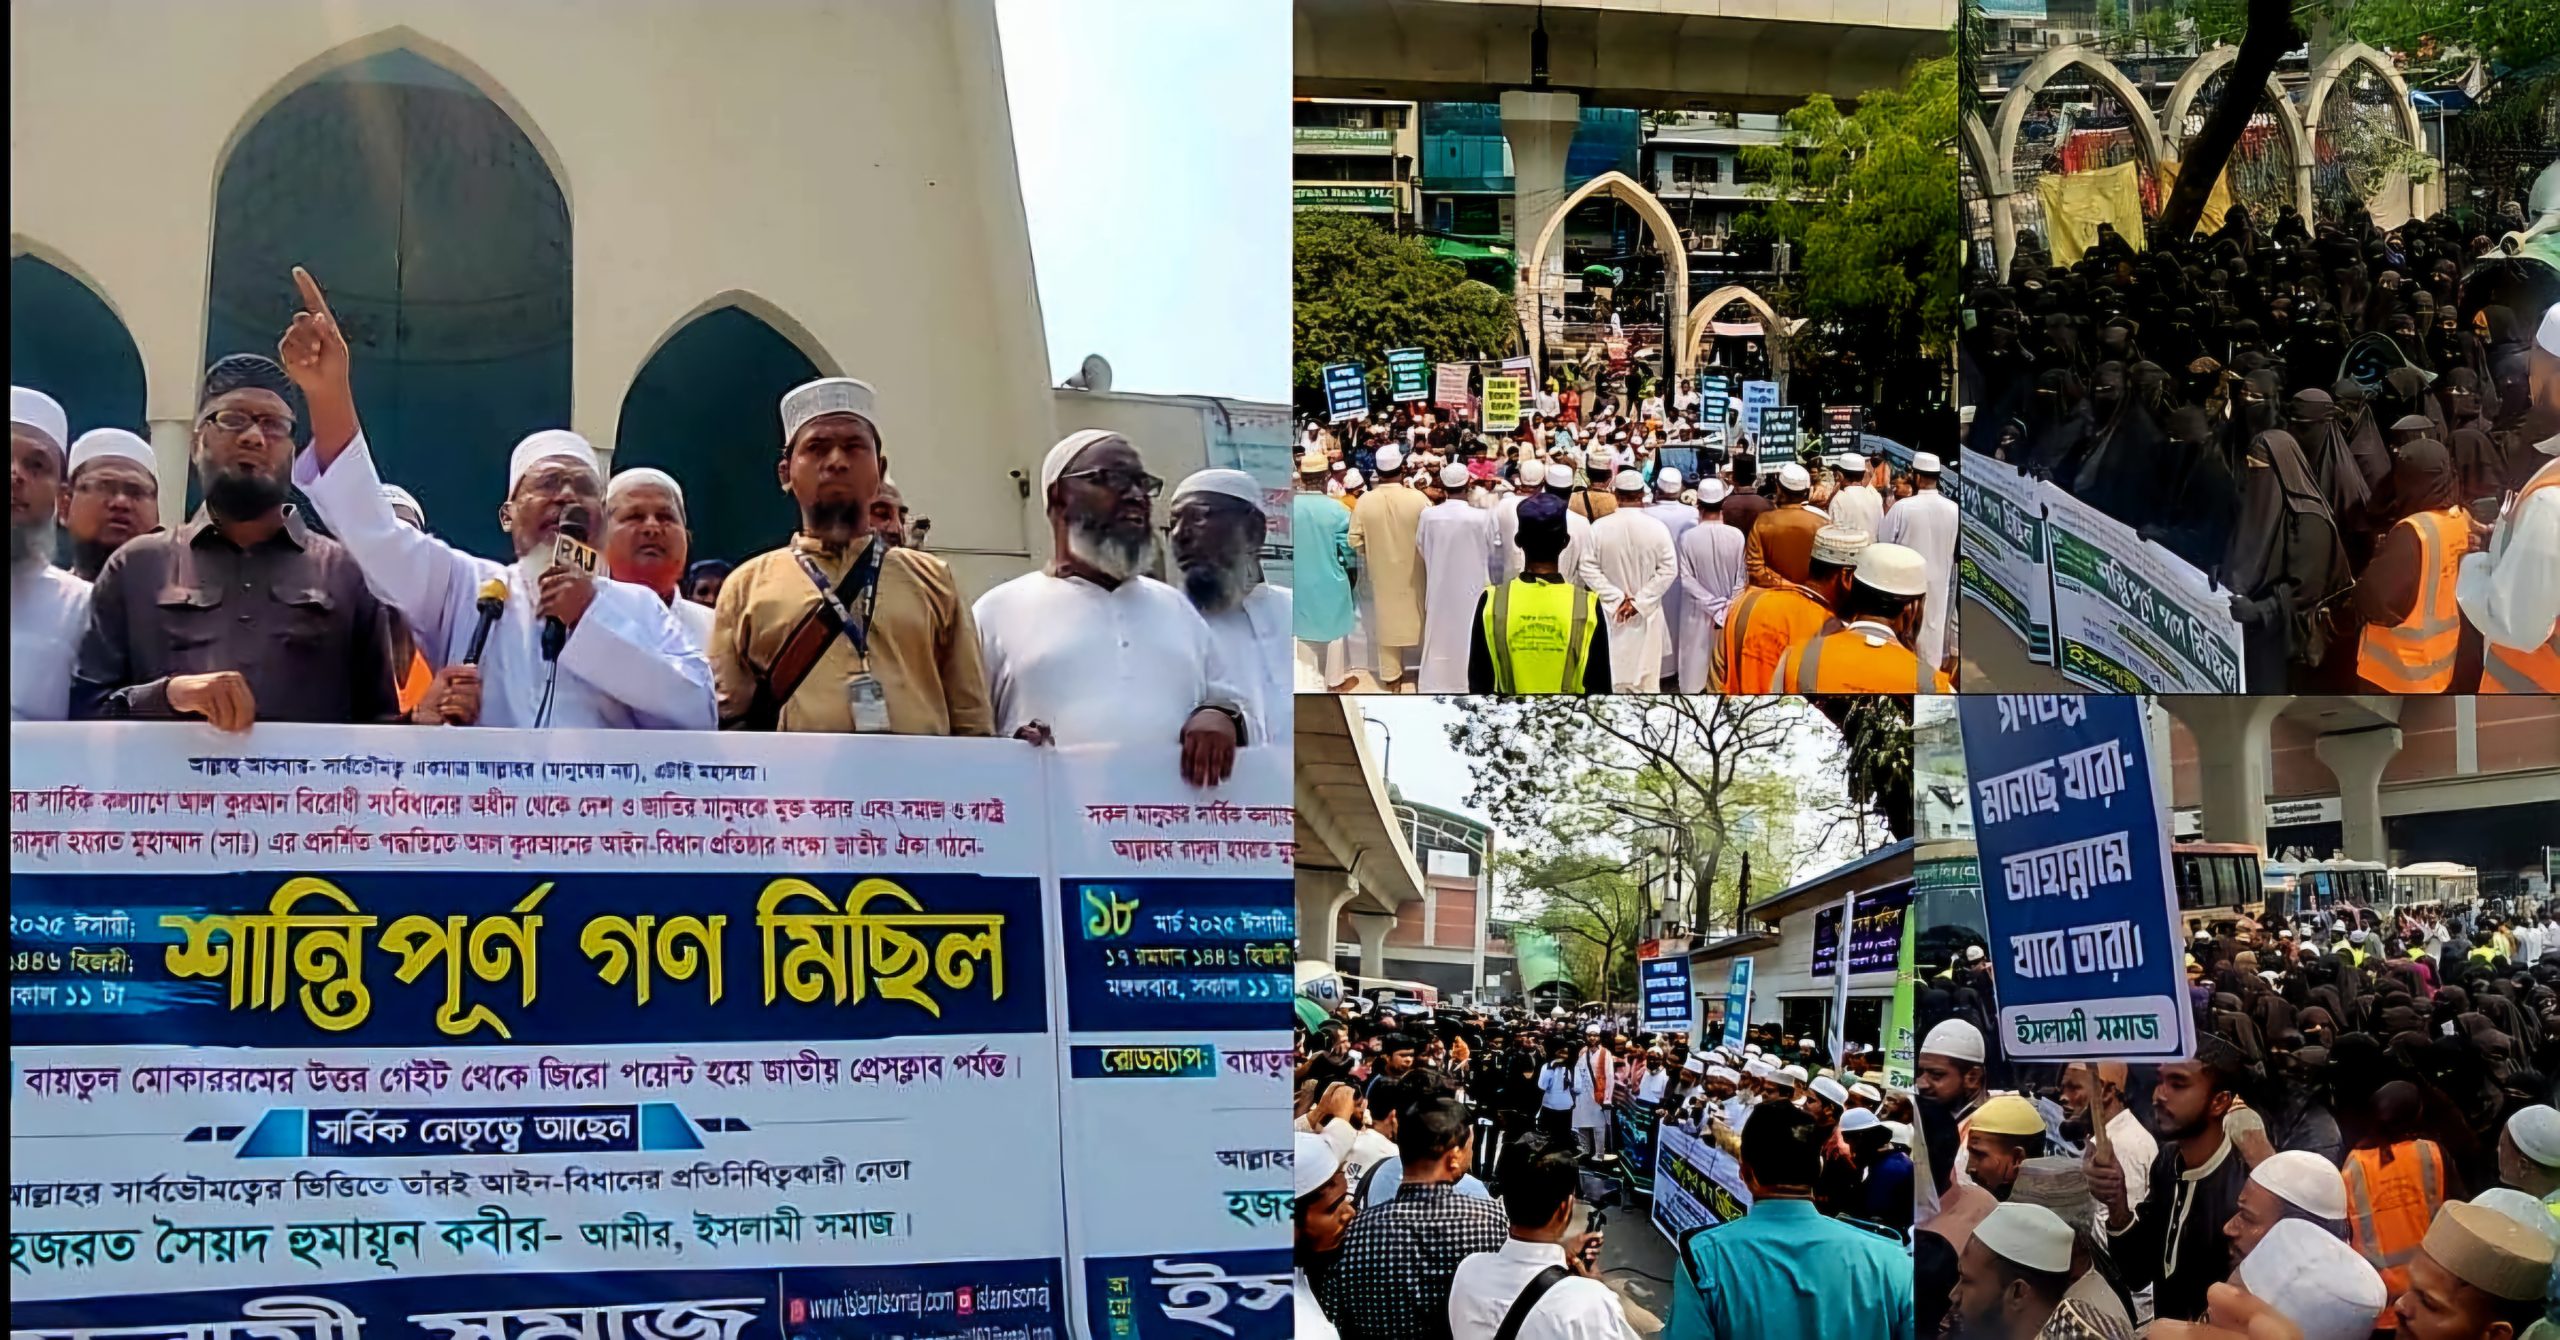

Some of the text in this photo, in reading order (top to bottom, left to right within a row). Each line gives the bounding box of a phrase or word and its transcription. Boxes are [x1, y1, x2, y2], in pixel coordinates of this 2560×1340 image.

[296, 787, 360, 816] বিরোধী
[526, 797, 571, 817] থেকে
[1977, 759, 2059, 824] মানছে
[268, 832, 298, 854] এর
[2001, 831, 2132, 901] জাহান্নামে
[1085, 888, 1140, 937] ১৮
[1190, 914, 1237, 937] ২০২৫
[159, 876, 1004, 1039] শান্তিপূর্ণ গণ মিছিল
[2011, 930, 2067, 978] যাবে
[66, 985, 92, 1006] ১১
[102, 980, 125, 1006] টা
[2015, 1007, 2159, 1044] ইসলামী সমাজ
[25, 1064, 121, 1102] বায়তুল
[132, 1064, 295, 1096] মোকাররমের
[304, 1060, 371, 1095] উত্তর
[380, 1058, 451, 1096] গেইট
[462, 1061, 529, 1092] থেকে
[539, 1055, 611, 1092] জিরো
[620, 1052, 693, 1090] পয়েন্ট
[705, 1058, 752, 1088] হয়ে
[761, 1048, 841, 1085] জাতীয়
[851, 1053, 943, 1092] প্রেসক্লাব
[315, 1109, 631, 1153] সার্বিক নেতৃত্বে আছেন
[110, 1171, 287, 1207] সার্বভৌমত্বের
[293, 1170, 388, 1202] ভিত্তিতে
[400, 1168, 473, 1199] তাঁরই
[671, 1155, 845, 1192] প্রতিনিধিত্বকারী
[857, 1159, 911, 1185] নেতা
[153, 1213, 275, 1265] সৈয়দ
[286, 1218, 426, 1272] হুমায়ূন
[437, 1204, 562, 1256] কবীর-
[578, 1211, 682, 1252] আমীর,
[694, 1206, 803, 1246] ইসলামী
